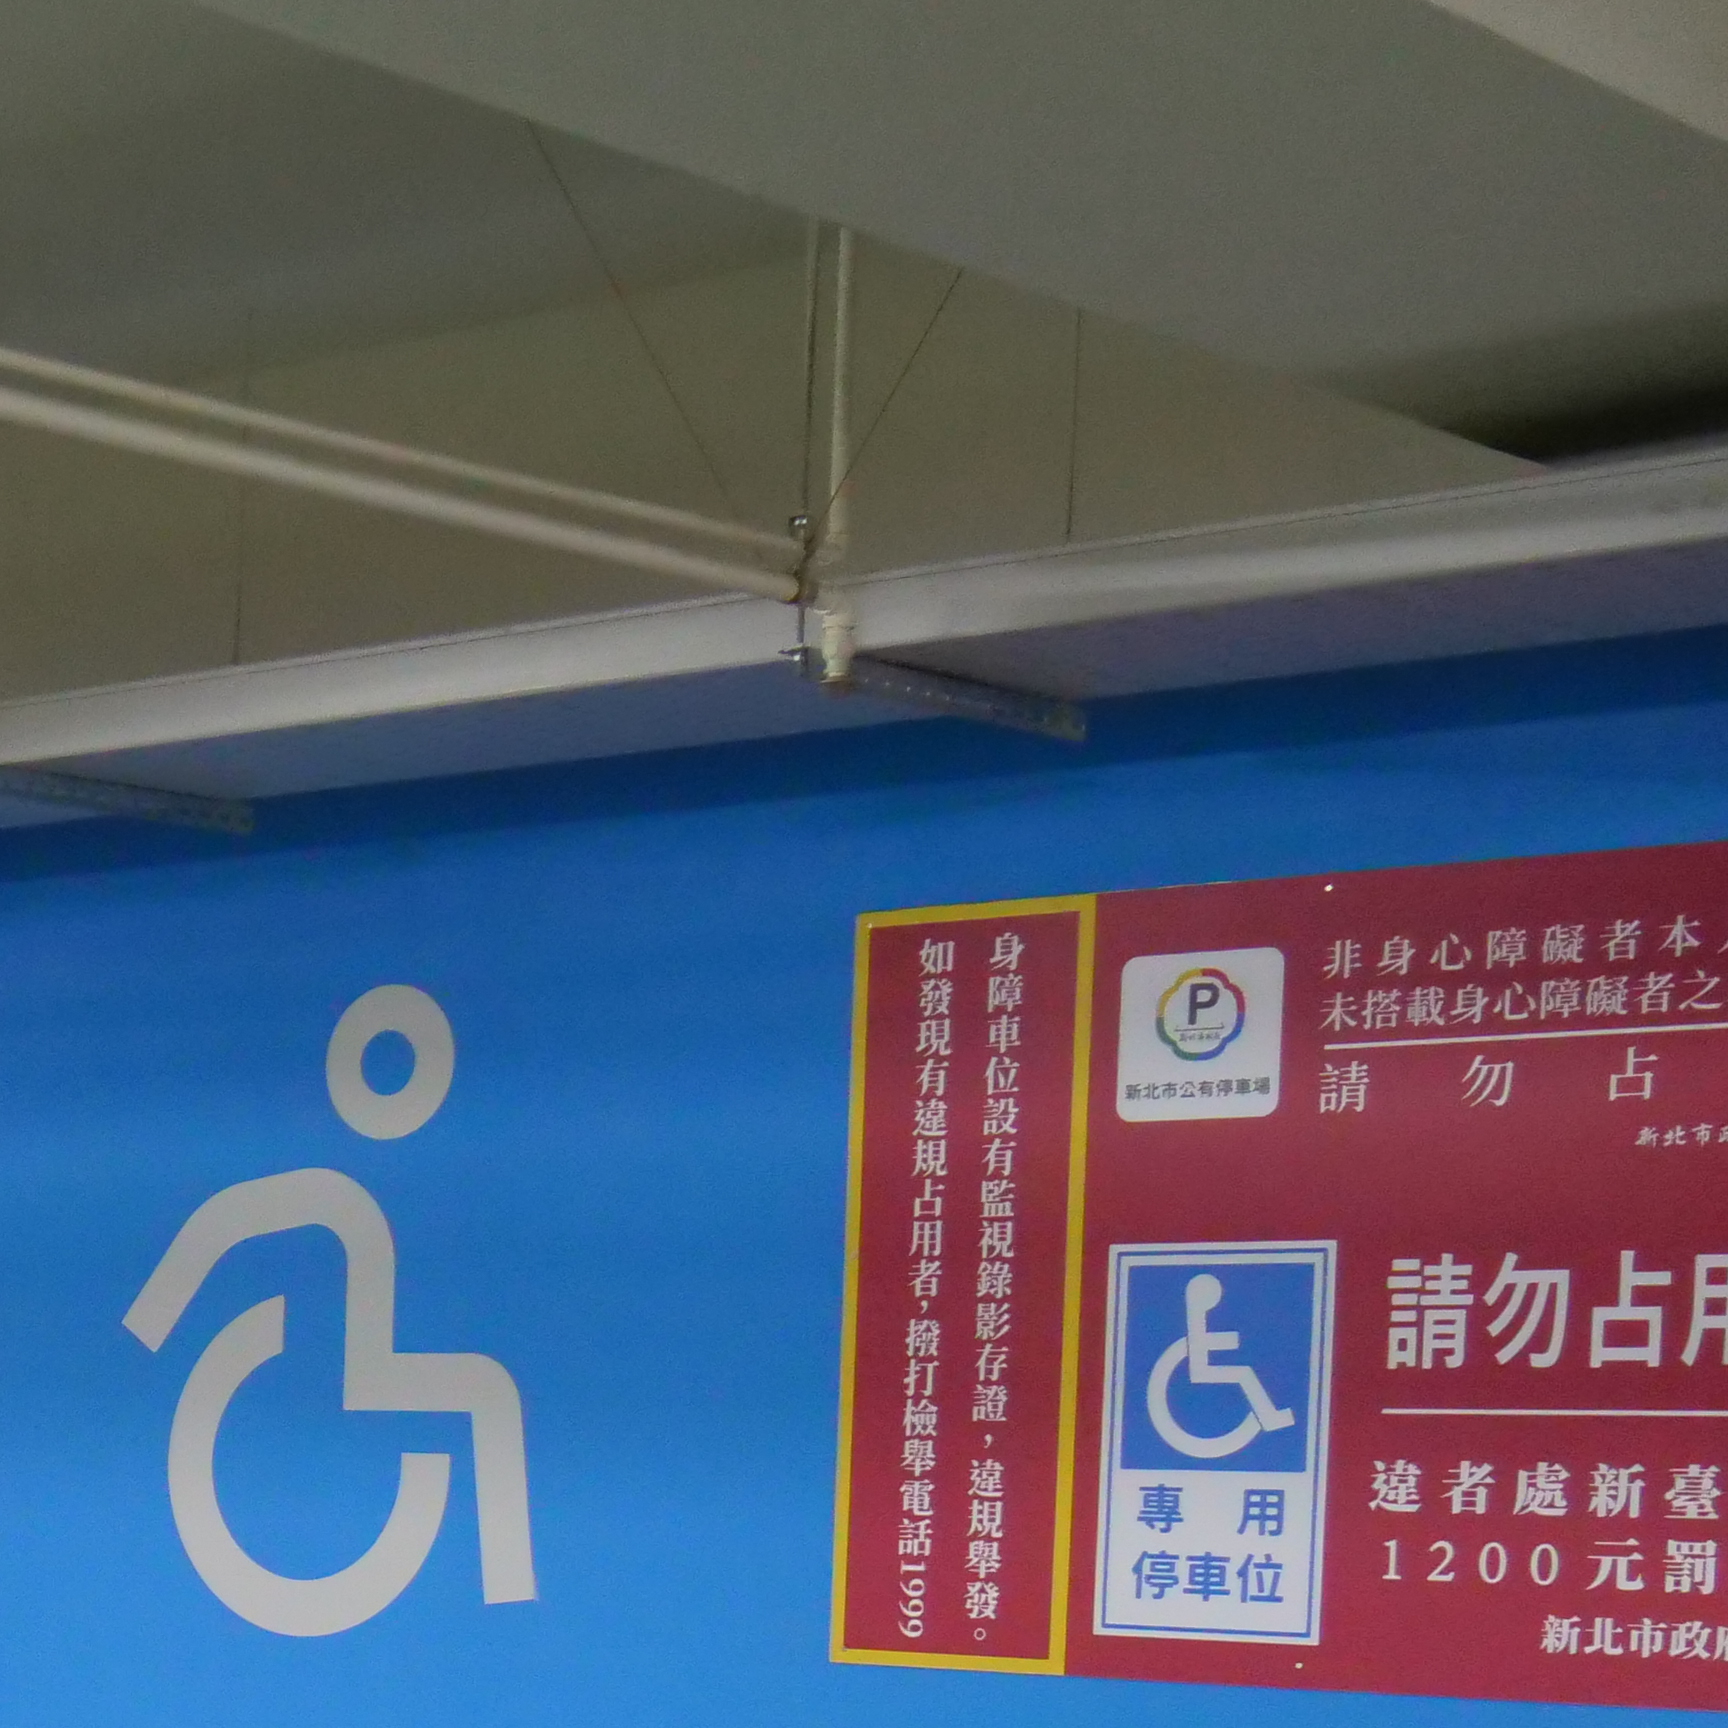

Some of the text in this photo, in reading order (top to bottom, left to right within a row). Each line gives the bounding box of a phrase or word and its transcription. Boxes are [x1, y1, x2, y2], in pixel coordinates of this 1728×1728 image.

[1322, 914, 1728, 978] 非身心障礙者本
[1188, 982, 1221, 1026] P
[1124, 1076, 1272, 1100] 新北市公有停車場
[1131, 1548, 1286, 1605] 停車位
